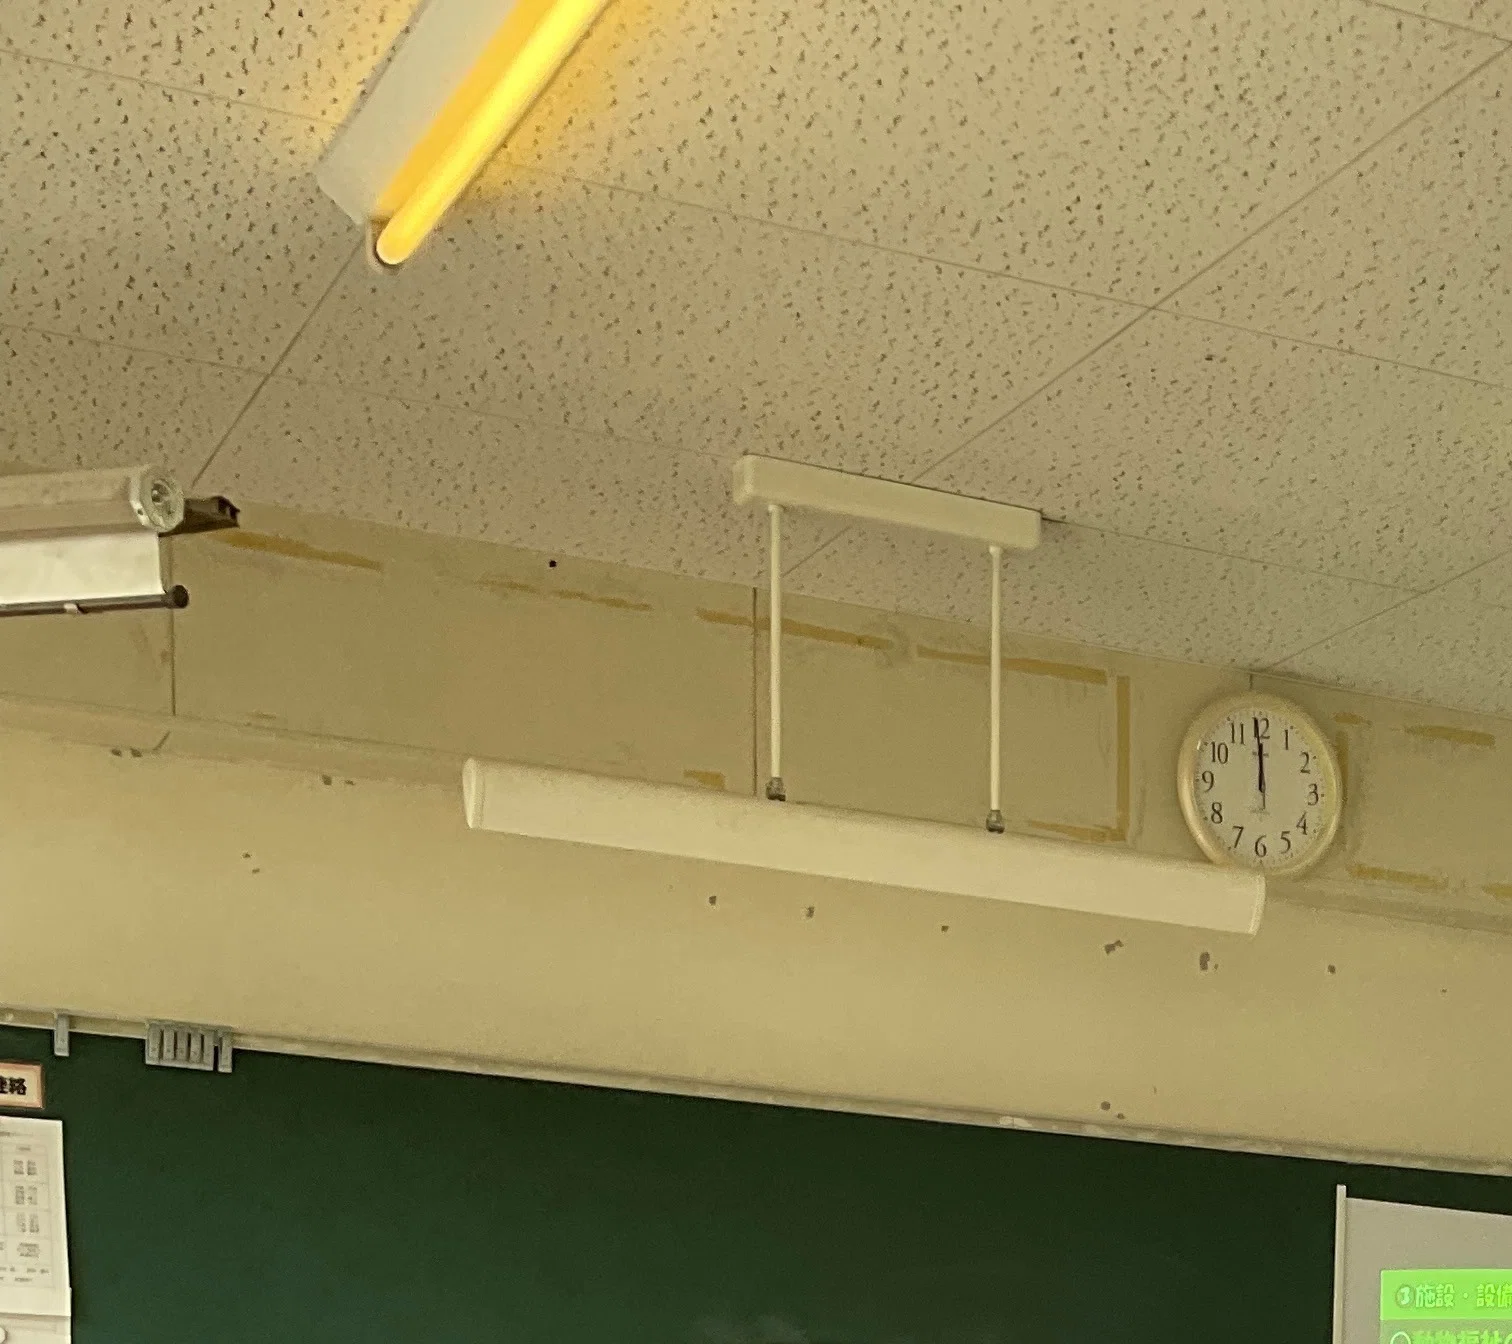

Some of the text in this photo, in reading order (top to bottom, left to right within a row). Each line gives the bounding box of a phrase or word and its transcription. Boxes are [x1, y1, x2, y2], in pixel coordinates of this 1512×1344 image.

[1230, 722, 1245, 746] 11
[1252, 716, 1270, 740] 12
[1283, 729, 1290, 751] 1
[1210, 741, 1229, 765] 10
[1299, 751, 1312, 774] 2
[1201, 770, 1215, 793] 9
[1307, 783, 1319, 806] 3
[1210, 801, 1224, 824] 8
[1295, 811, 1308, 835] 4
[1232, 825, 1245, 849] 7
[1254, 834, 1268, 858] 6
[1279, 831, 1292, 854] 5
